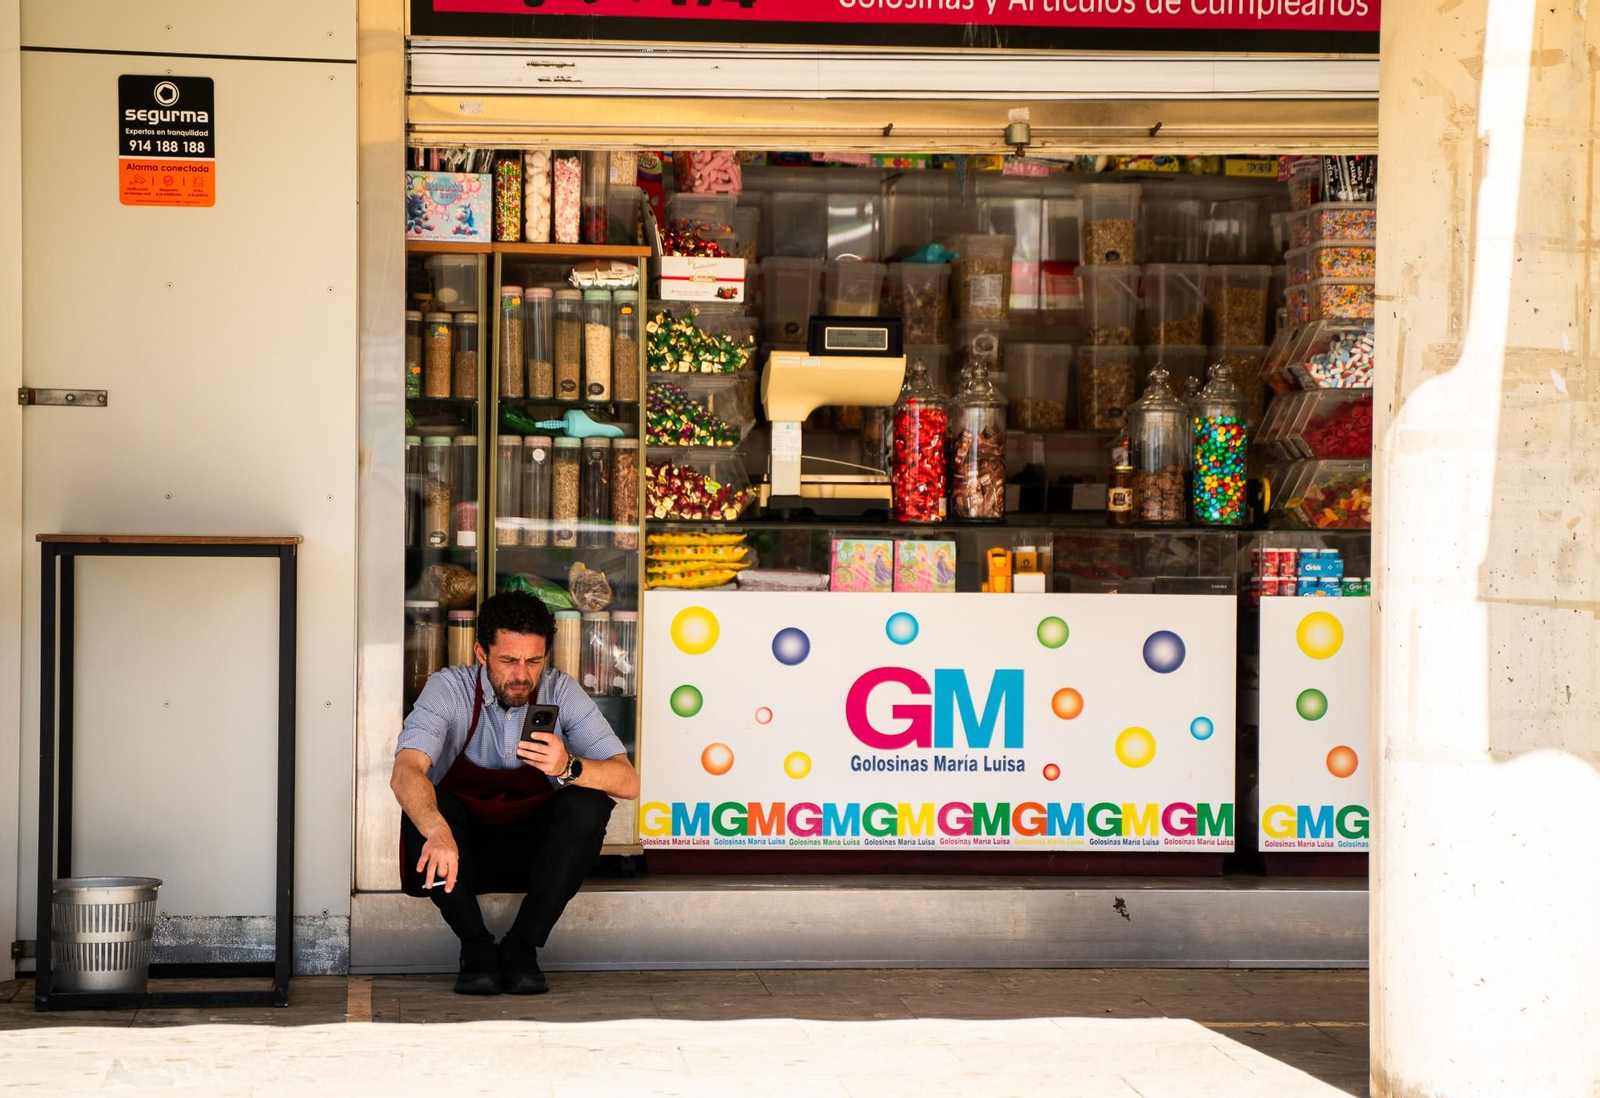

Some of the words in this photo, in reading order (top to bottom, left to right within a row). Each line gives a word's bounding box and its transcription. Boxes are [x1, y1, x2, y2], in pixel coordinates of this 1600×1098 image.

[125, 109, 208, 125] segurma
[125, 128, 155, 136] Expertos
[167, 128, 208, 137] tranquilidad
[129, 140, 151, 152] 914
[156, 140, 178, 153] 188
[183, 141, 205, 153] 188
[126, 163, 158, 172] Alarma
[161, 164, 209, 173] conectada
[1304, 563, 1322, 571] Orbit
[845, 666, 1025, 750] GM
[850, 755, 928, 772] Golosinas
[934, 754, 978, 772] María
[984, 755, 1025, 772] Luisa
[639, 801, 710, 837] GM
[711, 801, 786, 837] GM
[786, 802, 861, 837] GM
[862, 802, 935, 837] GM
[937, 801, 1011, 837] GM
[1011, 801, 1085, 837] GM
[1087, 802, 1160, 837] GM
[1161, 802, 1234, 837] GM
[1261, 804, 1334, 839] GM
[692, 838, 710, 846] Luisa
[714, 838, 746, 846] Golosinas
[768, 838, 786, 846] Luisa
[789, 838, 821, 846] Golosinas
[843, 838, 861, 846] Luisa
[864, 838, 896, 846] Golosinas
[917, 838, 936, 846] Luisa
[940, 837, 971, 845] Golosinas
[993, 837, 1011, 845] Luisa
[1089, 838, 1121, 846] Golosinas
[1142, 838, 1160, 846] Luisa
[1164, 838, 1196, 846] Golosinas
[1217, 838, 1234, 846] Luisa
[1264, 840, 1296, 848] Golosinas
[1317, 840, 1334, 848] Luisa
[1338, 840, 1369, 848] Golosinas
